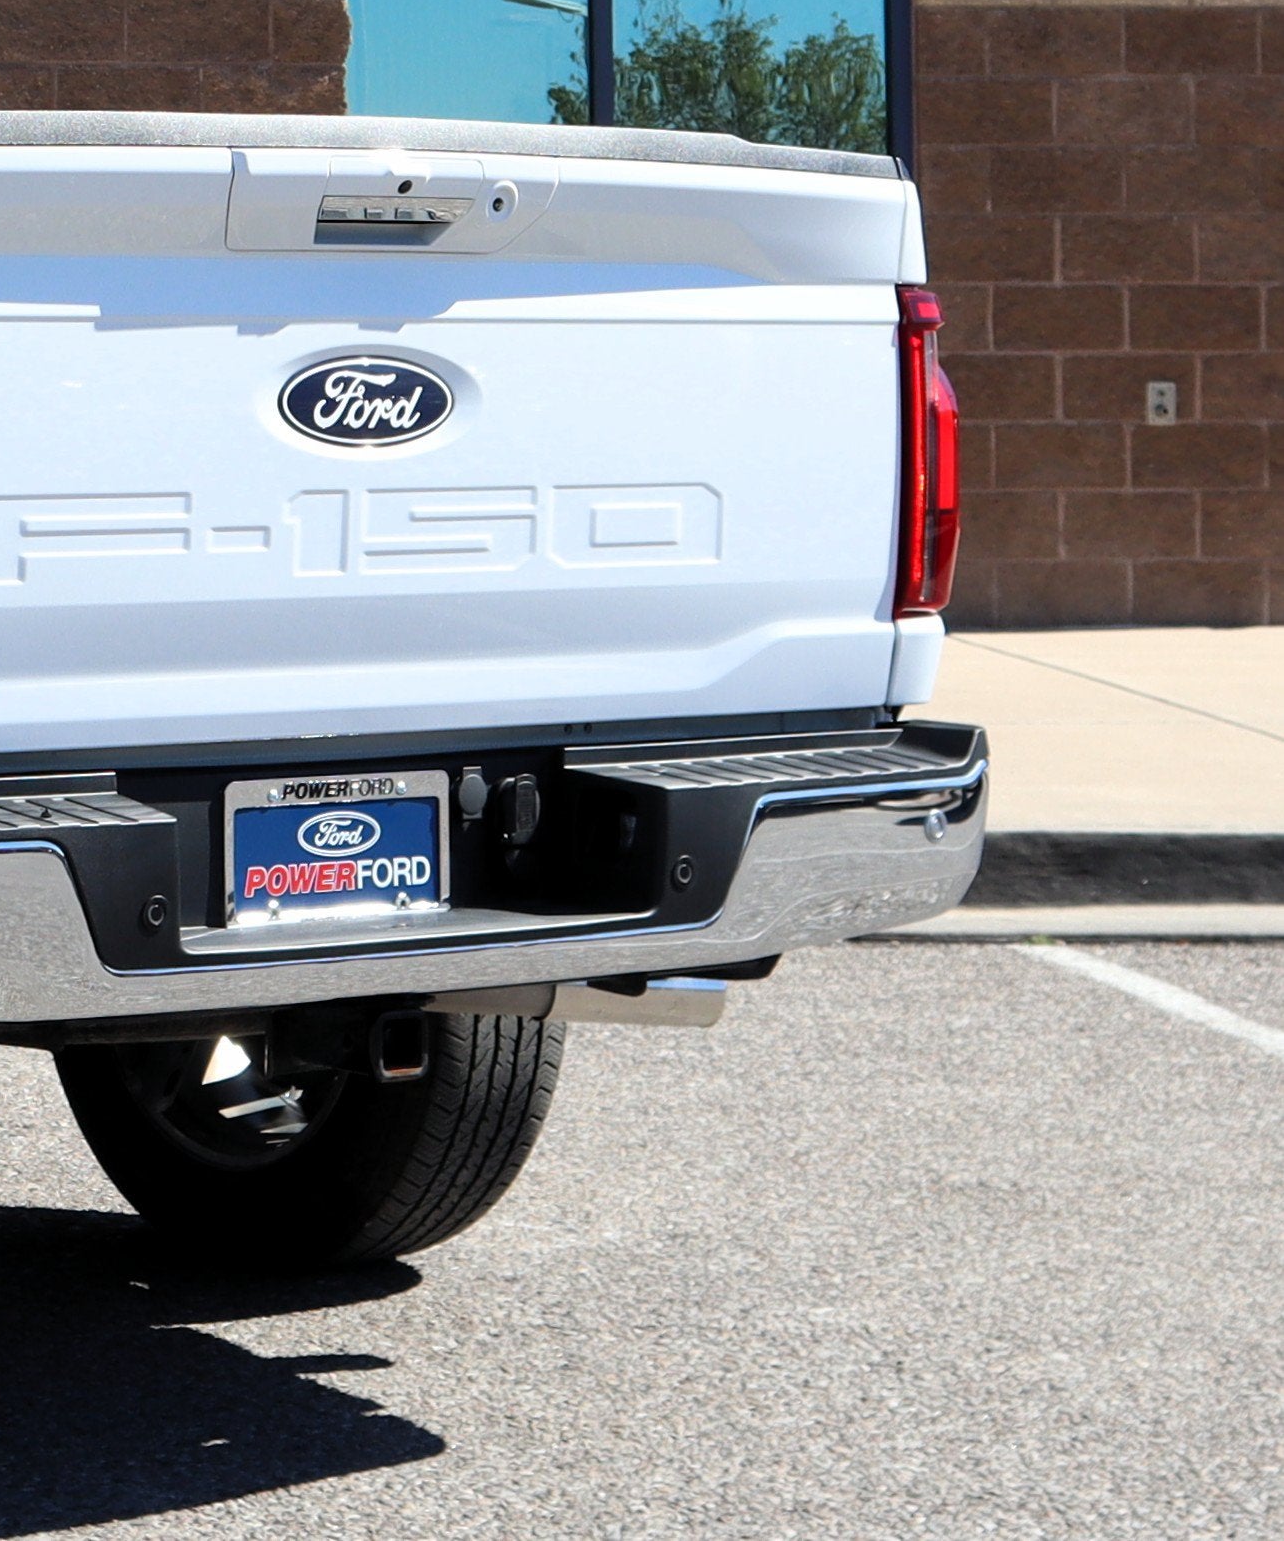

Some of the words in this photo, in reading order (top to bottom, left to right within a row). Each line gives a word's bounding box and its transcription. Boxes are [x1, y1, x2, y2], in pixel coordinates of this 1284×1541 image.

[313, 369, 424, 430] Ford
[281, 777, 394, 800] POWERFORD
[314, 819, 363, 847] Ford
[244, 855, 431, 898] POWERFORD
